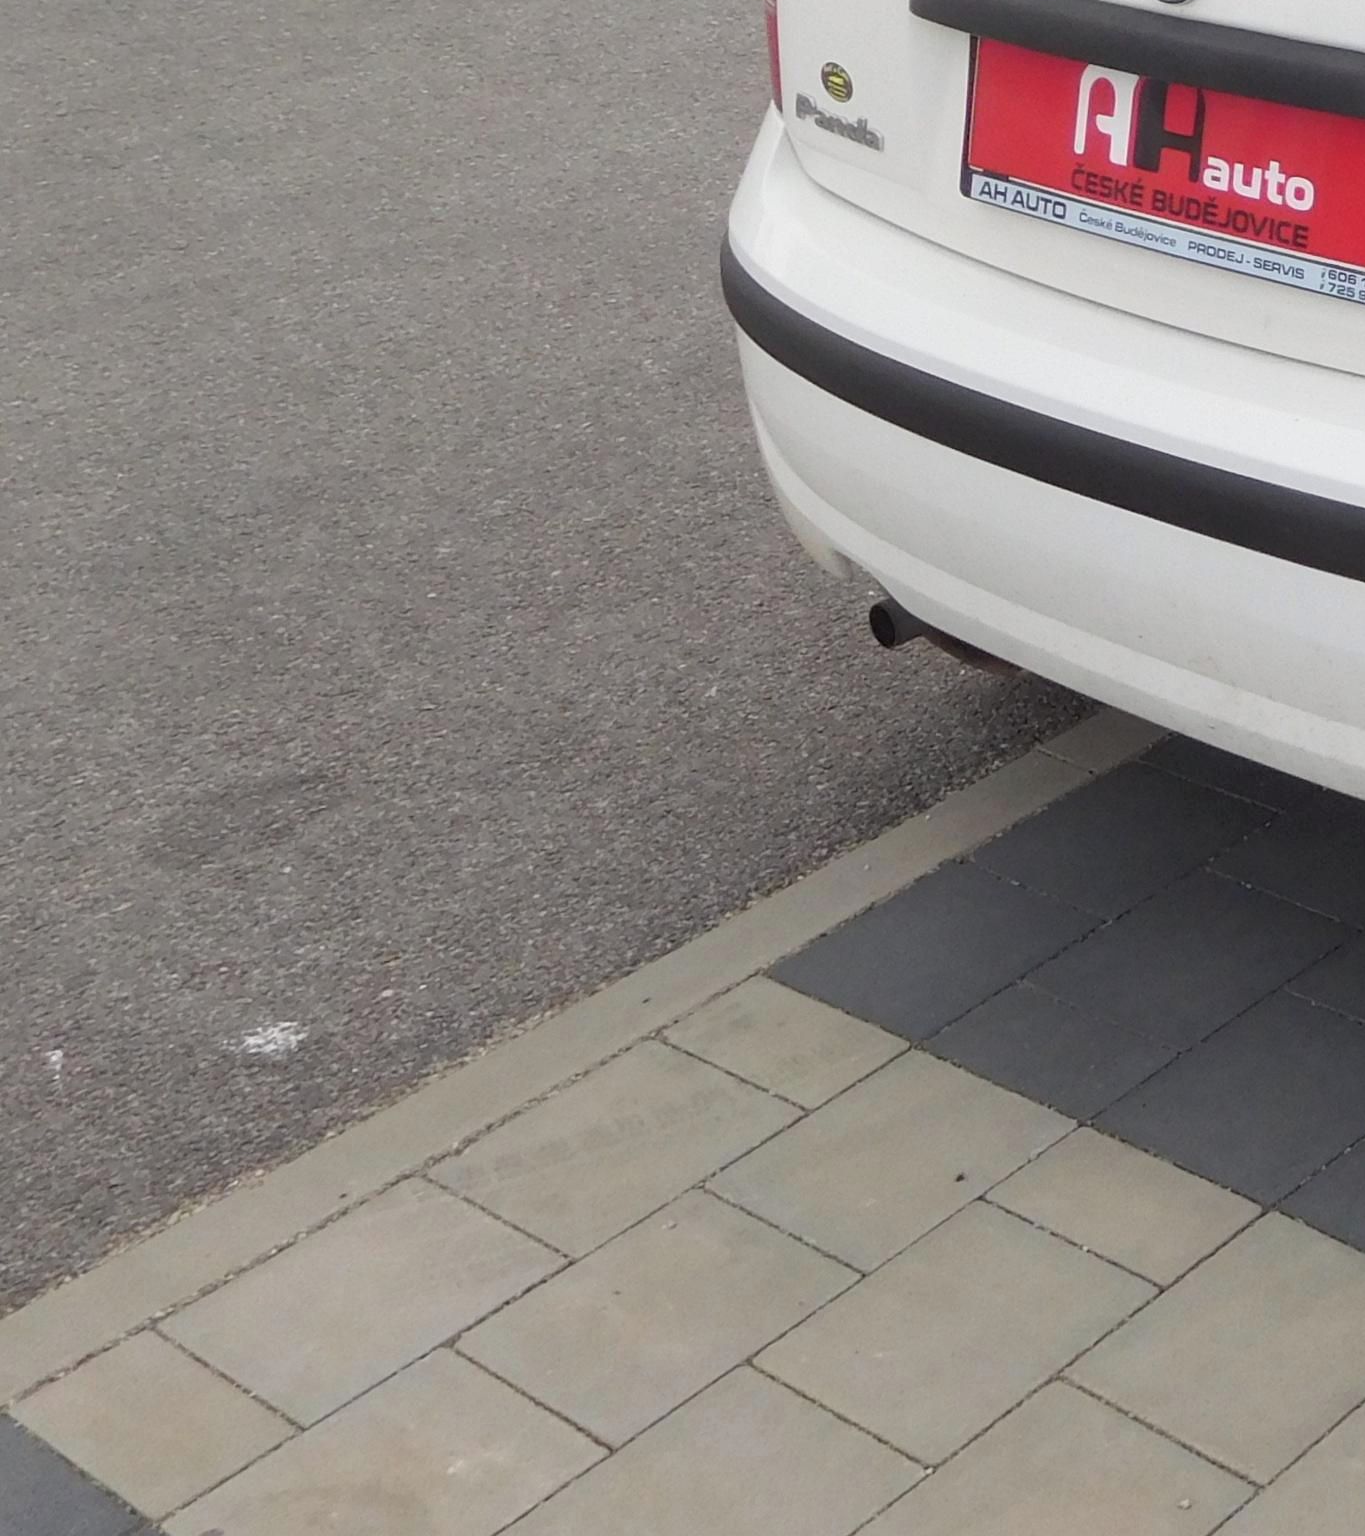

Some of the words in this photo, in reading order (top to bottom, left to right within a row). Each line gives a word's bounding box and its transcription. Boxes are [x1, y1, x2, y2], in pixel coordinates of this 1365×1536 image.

[978, 181, 1008, 203] AH
[1011, 189, 1067, 220] AUTO
[1079, 208, 1113, 230] České
[1114, 221, 1177, 248] Budějovice
[1187, 240, 1245, 265] PRODEJ
[1253, 257, 1305, 280] SERVIS
[1071, 162, 1144, 207] ČESKÉ
[1151, 188, 1310, 249] BUDĚJOVICE
[1327, 282, 1356, 298] 725
[1328, 269, 1357, 285] 606
